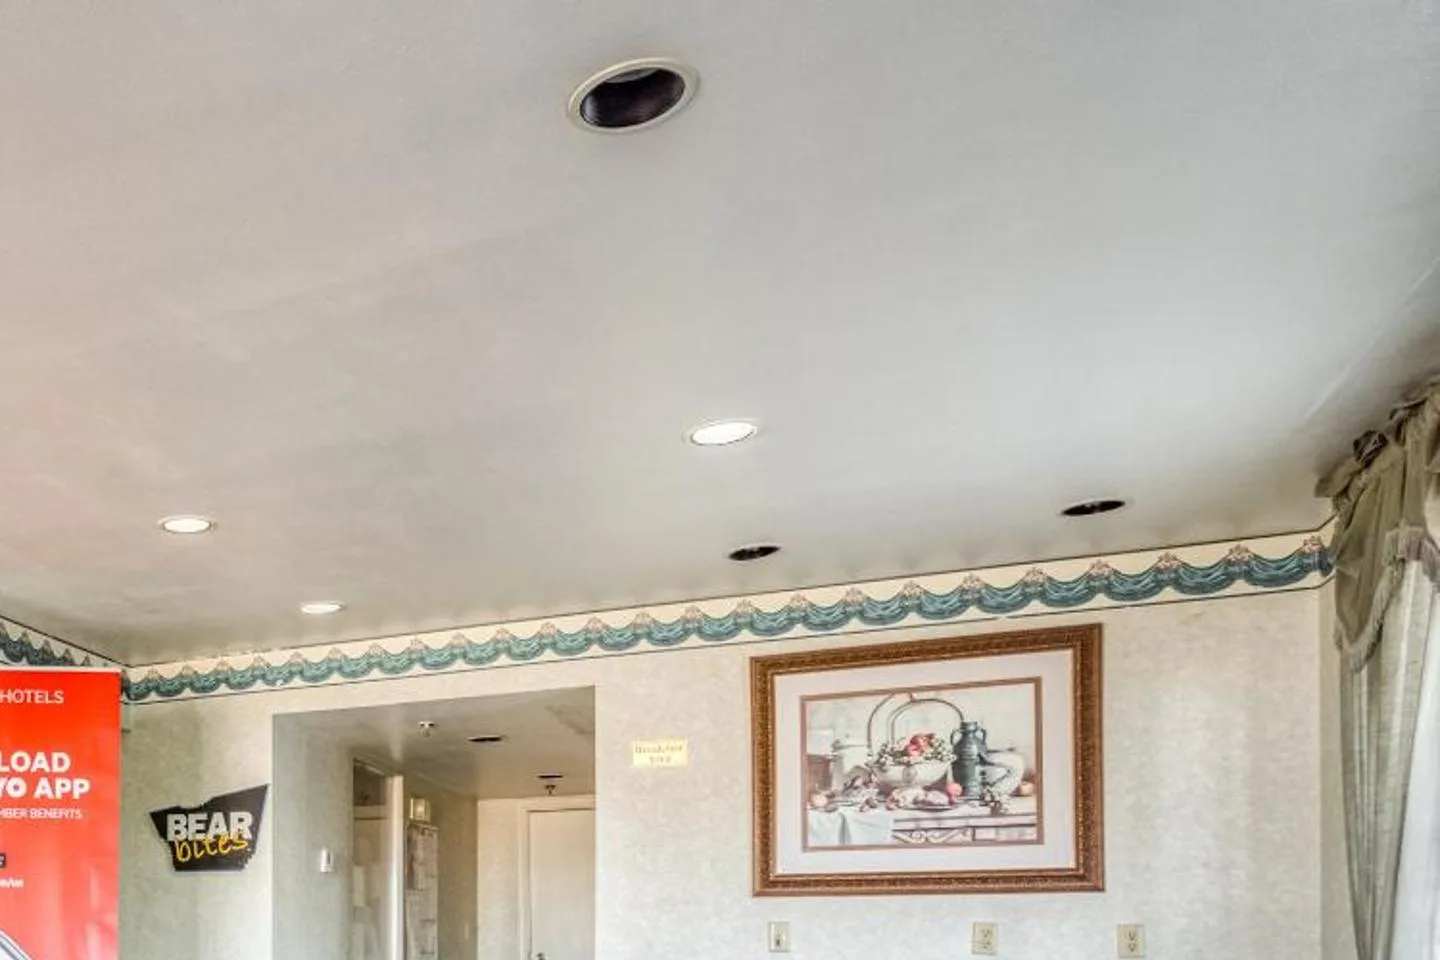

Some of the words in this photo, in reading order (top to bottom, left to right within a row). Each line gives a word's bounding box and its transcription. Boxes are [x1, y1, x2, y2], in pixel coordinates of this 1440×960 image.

[0, 689, 65, 705] HOTELS
[34, 777, 91, 799] APP
[29, 808, 82, 819] BENEFITS
[166, 811, 253, 841] BEAR
[174, 834, 249, 863] bites
